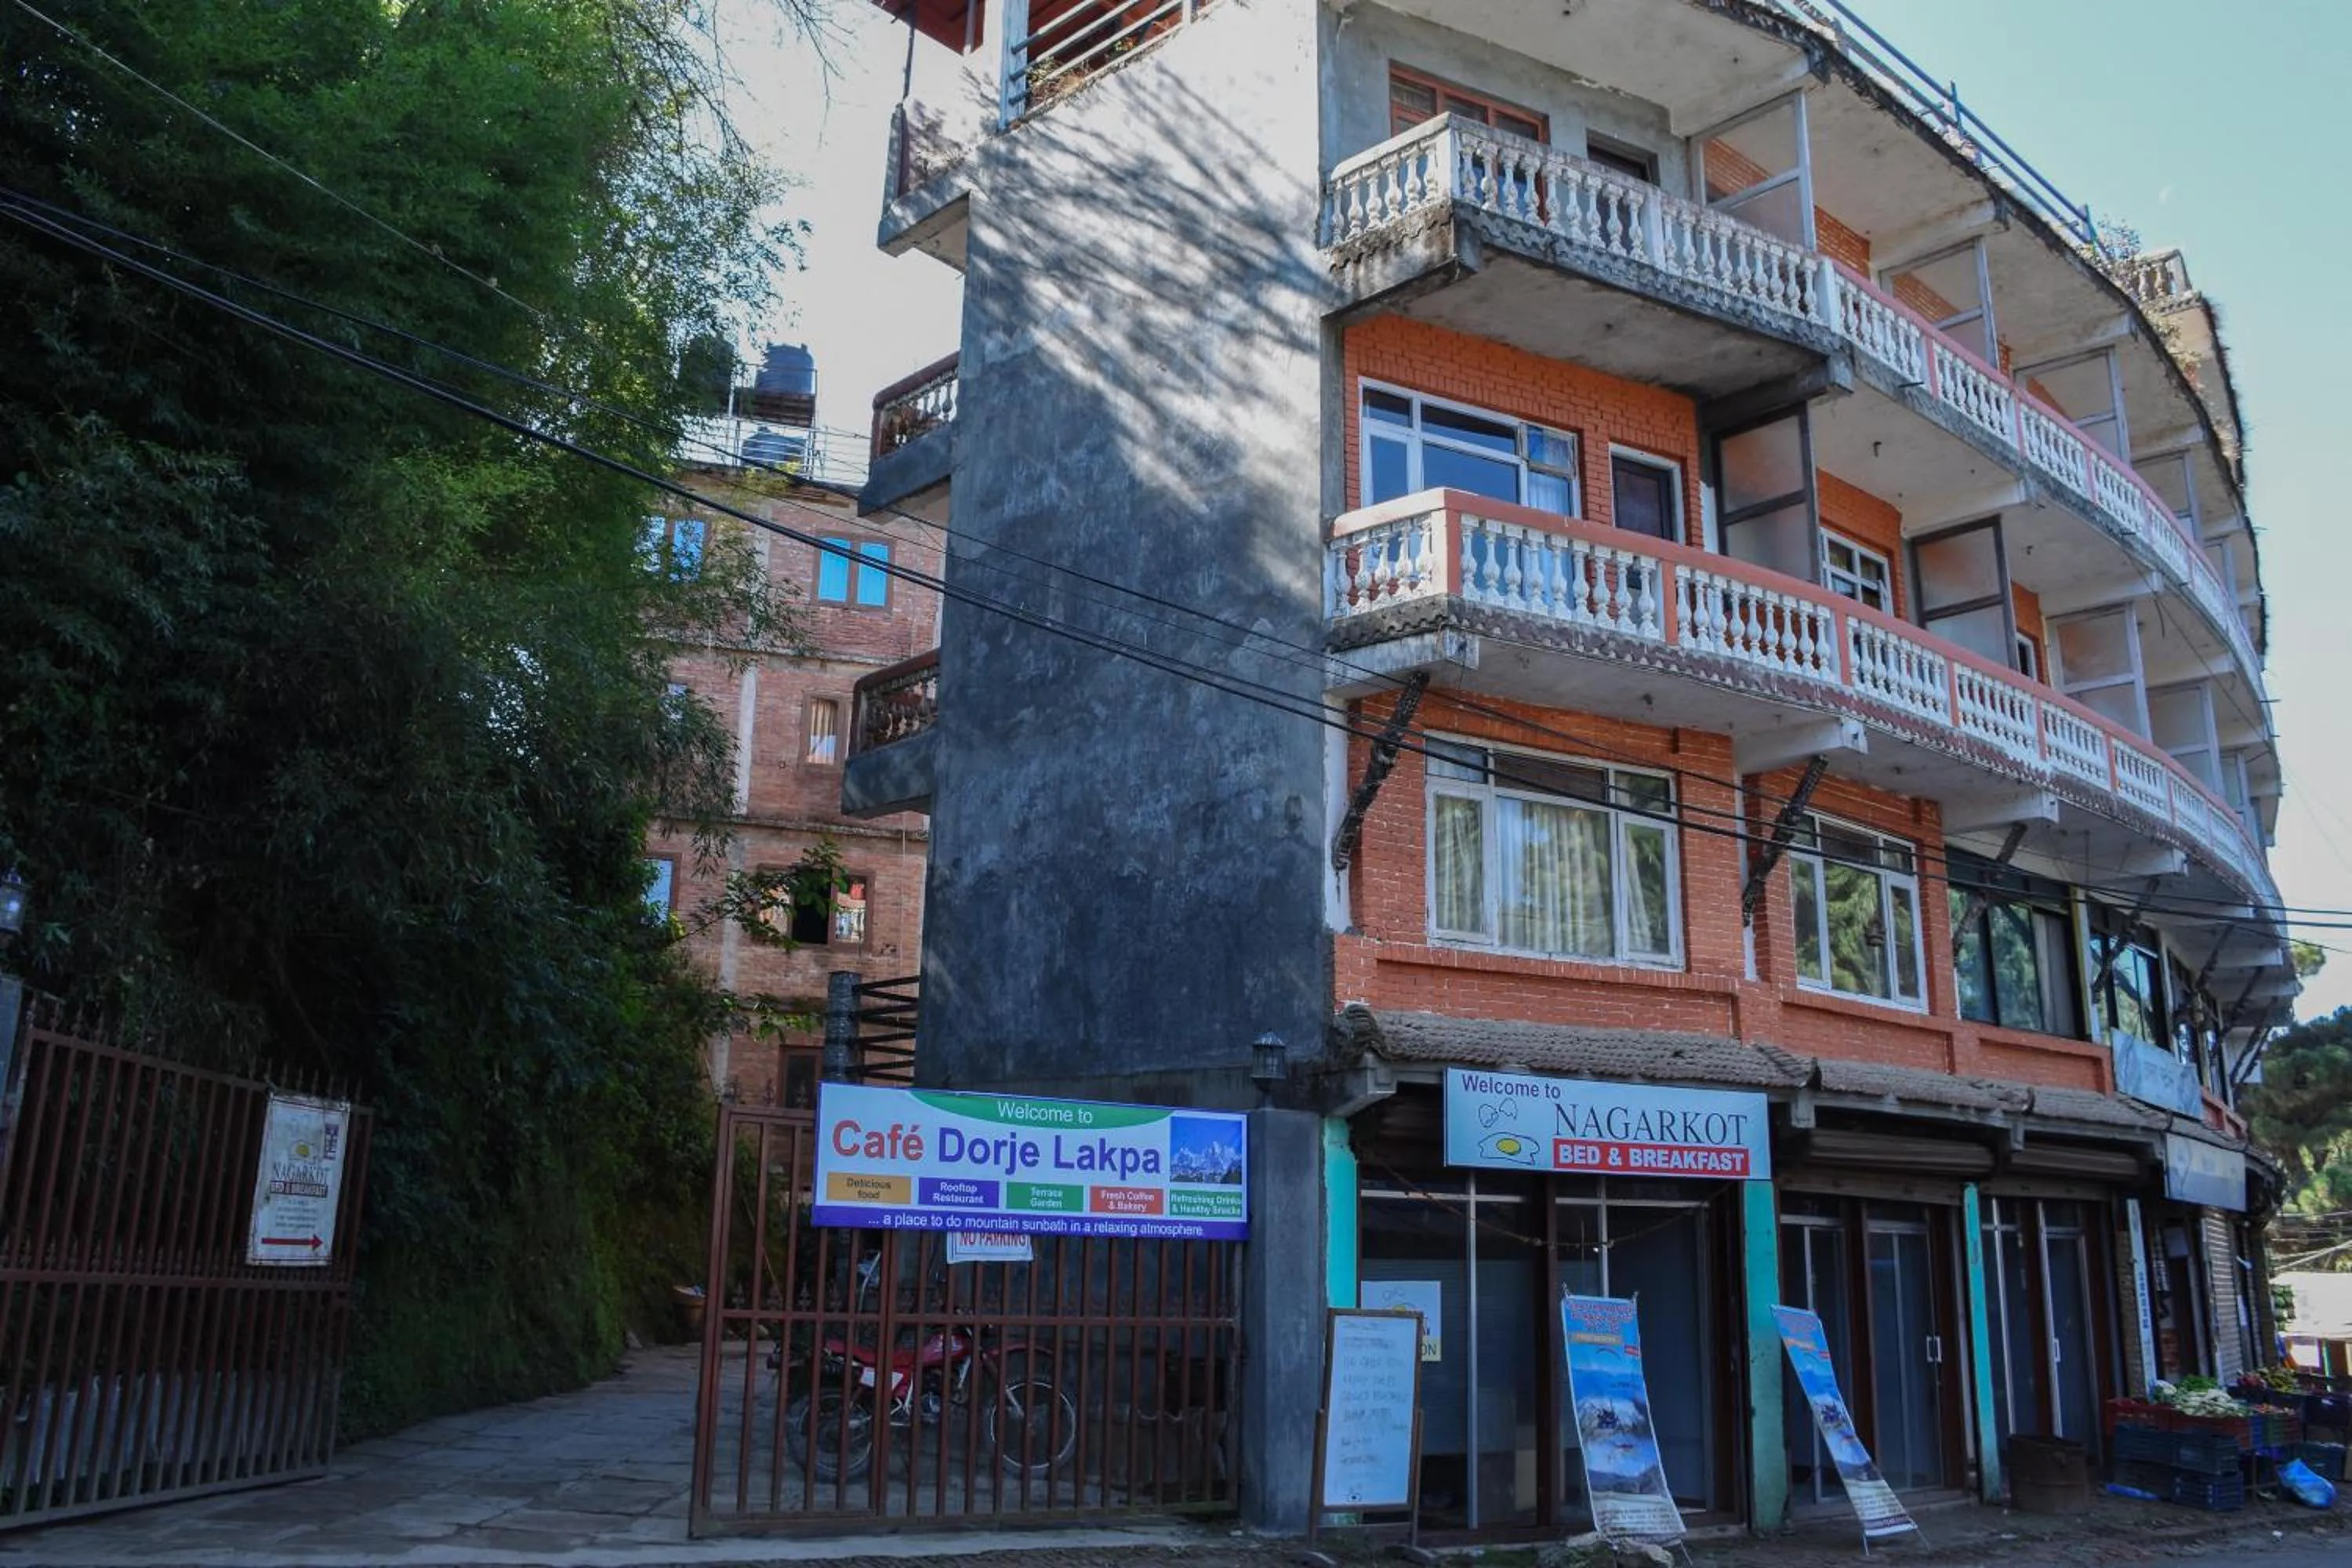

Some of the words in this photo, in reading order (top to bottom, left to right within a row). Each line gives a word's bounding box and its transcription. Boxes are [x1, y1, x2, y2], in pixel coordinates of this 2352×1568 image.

[1461, 1073, 1539, 1098] Welcome
[1544, 1083, 1561, 1099] to
[997, 1101, 1073, 1123] Welcome
[1078, 1108, 1093, 1123] to
[1555, 1103, 1748, 1145] NAGARKOT
[833, 1120, 924, 1161] Café
[939, 1127, 1040, 1175] Dorje
[1054, 1134, 1160, 1181] Lakpa
[1559, 1145, 1600, 1165] BED
[1607, 1148, 1622, 1167] &
[1629, 1149, 1744, 1172] BREAKFAST
[846, 1178, 891, 1189] Delicious
[940, 1181, 978, 1194] Rooftop
[857, 1189, 880, 1200] food
[1031, 1186, 1063, 1197] Terrace
[1101, 1189, 1126, 1200] Fresh
[1127, 1191, 1155, 1202] Coffee
[933, 1193, 984, 1204] Restaurant
[1030, 1197, 1062, 1208] Garden
[1108, 1201, 1116, 1210] &
[1117, 1202, 1147, 1213] Bakery
[883, 1216, 891, 1225] a
[895, 1214, 927, 1228] place
[931, 1215, 943, 1227] to
[946, 1214, 961, 1228] do
[965, 1216, 1018, 1229] mountain
[1022, 1218, 1067, 1232] sunbath
[1070, 1220, 1081, 1232] in
[1083, 1223, 1091, 1232] a
[1094, 1221, 1138, 1236] relaxing
